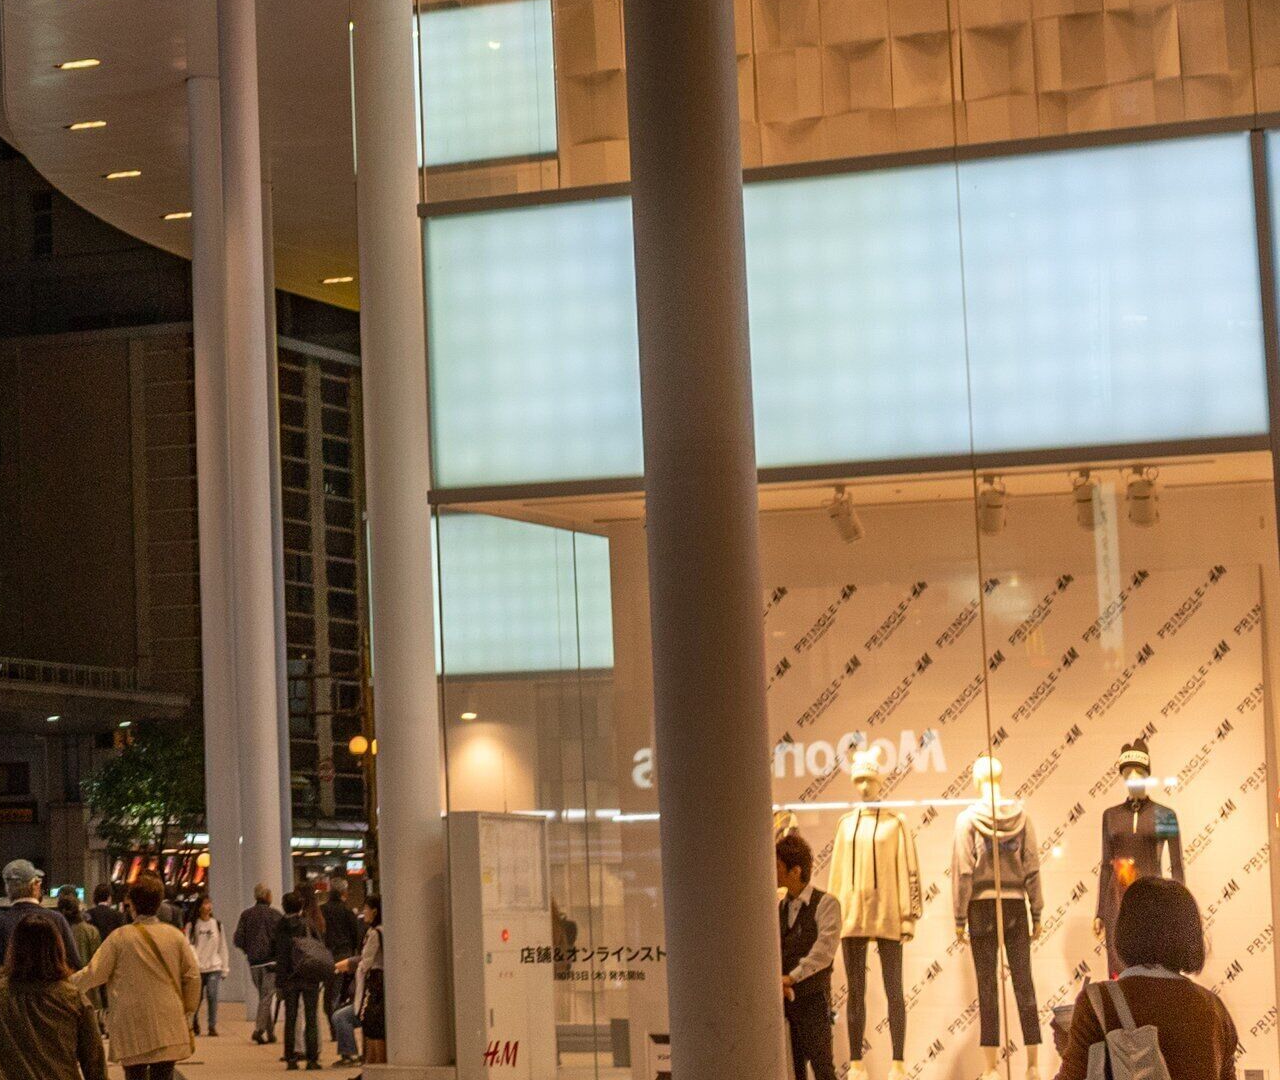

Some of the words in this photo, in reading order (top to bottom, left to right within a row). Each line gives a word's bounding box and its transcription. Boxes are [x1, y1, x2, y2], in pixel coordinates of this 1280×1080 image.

[1008, 594, 1054, 647] PRINGLE
[1156, 586, 1205, 640] PRINGLE
[796, 679, 841, 728] PRINGLE
[867, 676, 912, 726] PRINGLE
[1011, 669, 1058, 722] PRINGLE
[1085, 667, 1134, 720] PRINGLE
[1160, 664, 1208, 717] PRINGLE
[1014, 747, 1061, 800] PRINGLE
[482, 1039, 519, 1068] H&M
